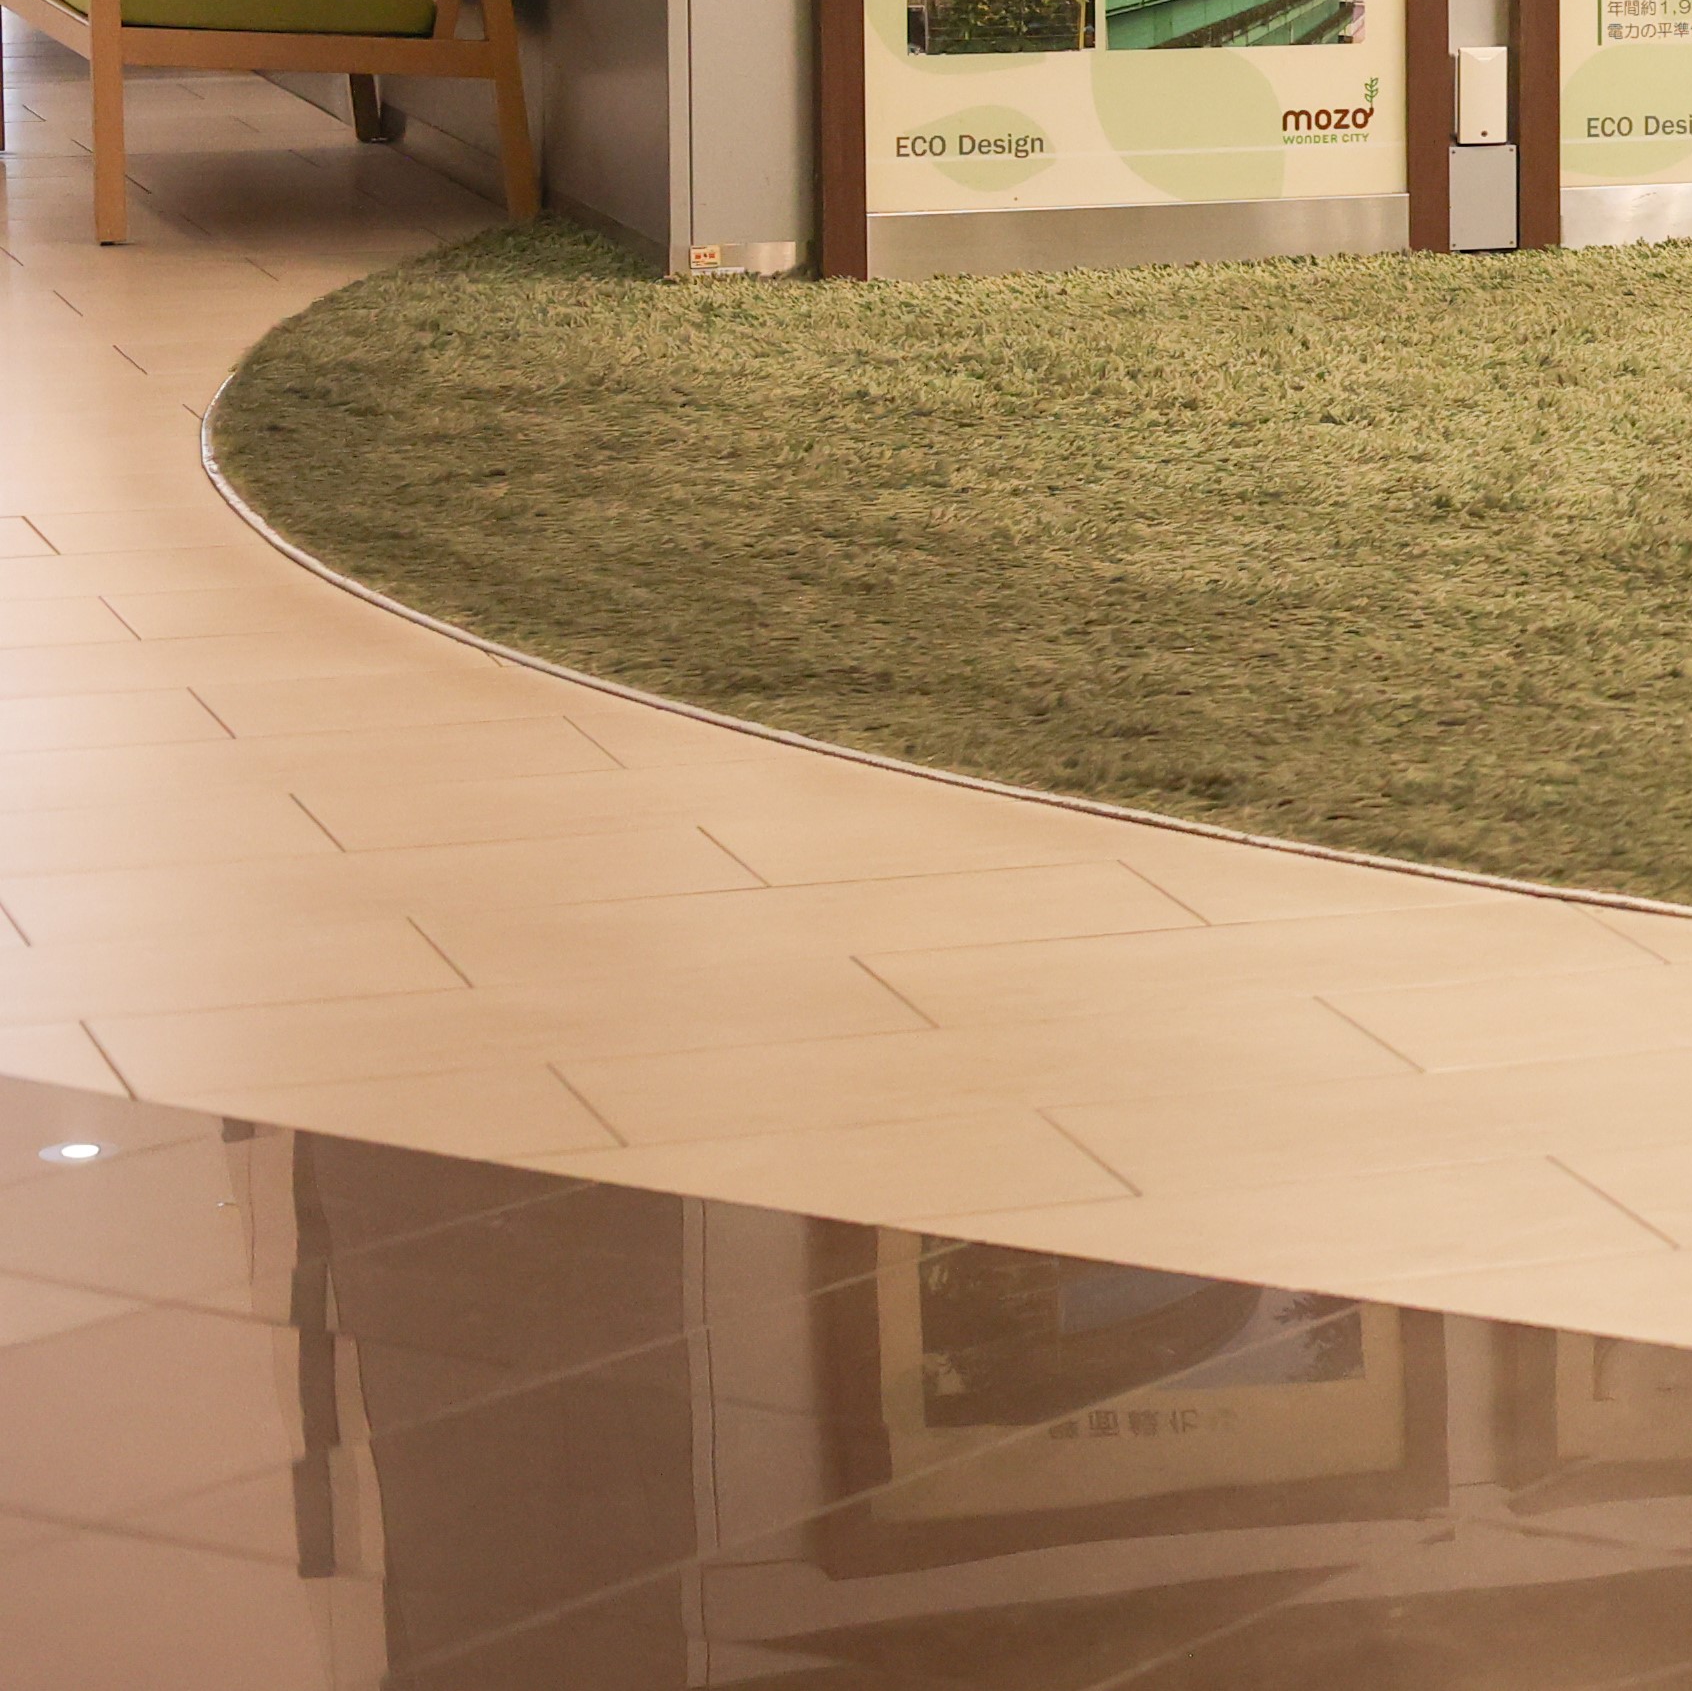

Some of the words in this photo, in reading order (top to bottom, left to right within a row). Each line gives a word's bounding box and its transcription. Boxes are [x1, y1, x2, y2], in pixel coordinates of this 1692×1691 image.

[1282, 107, 1374, 132] mozo
[1587, 116, 1633, 138] ECO
[895, 135, 946, 158] ECO
[958, 133, 1045, 160] Design
[1282, 134, 1338, 145] WONDER
[1341, 132, 1370, 144] CITY
